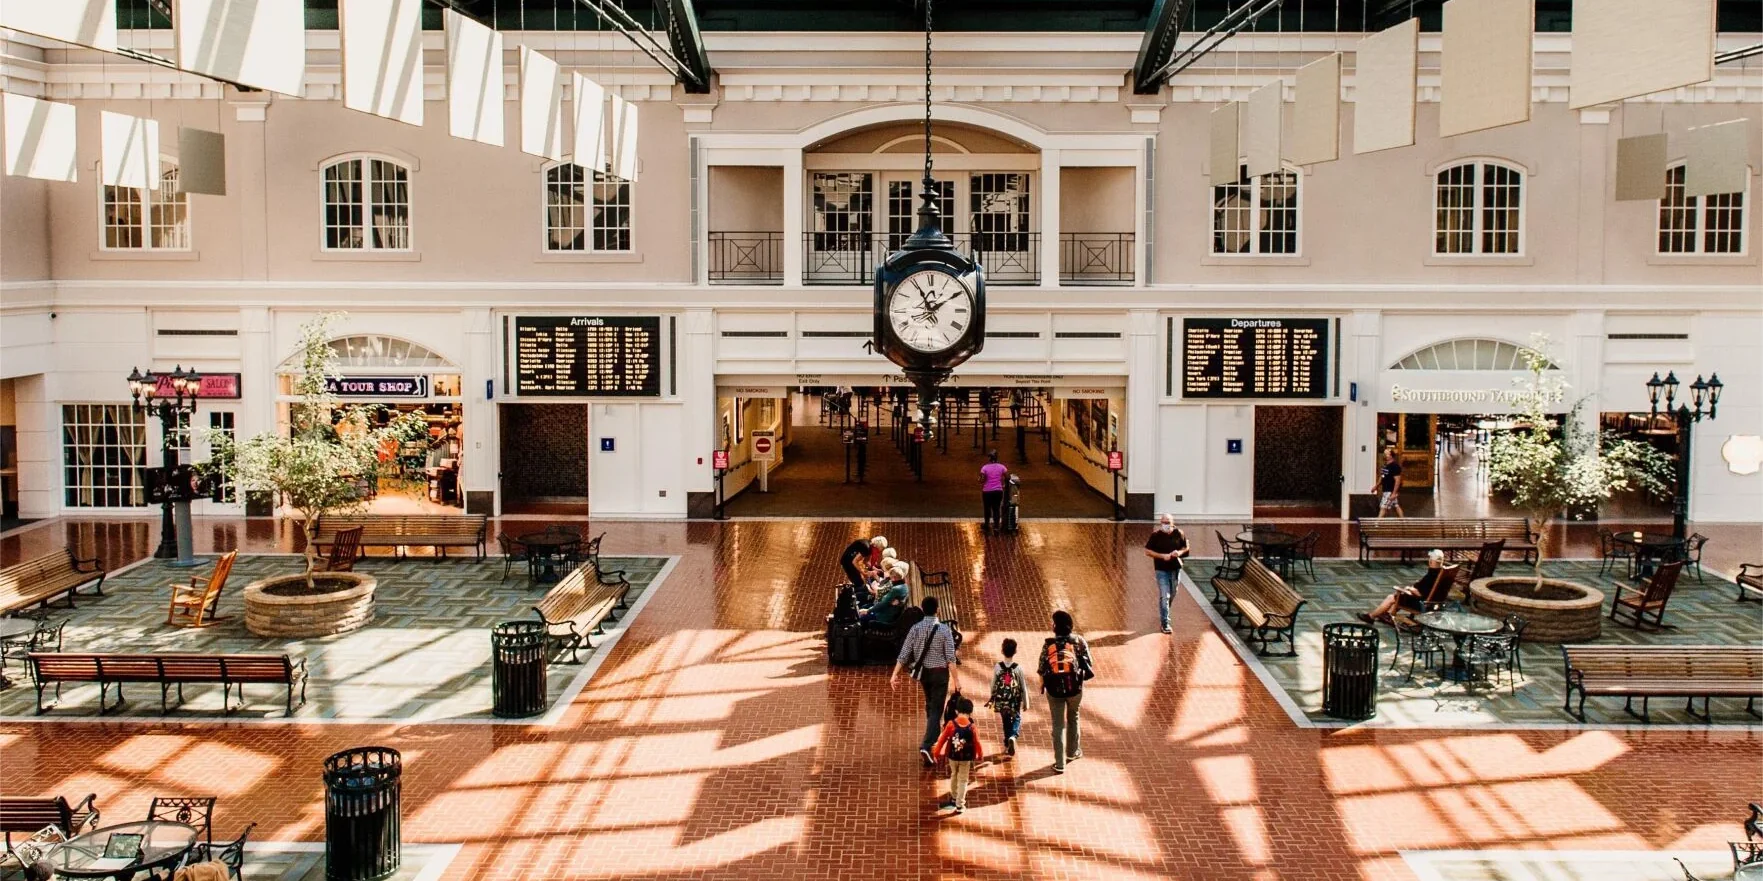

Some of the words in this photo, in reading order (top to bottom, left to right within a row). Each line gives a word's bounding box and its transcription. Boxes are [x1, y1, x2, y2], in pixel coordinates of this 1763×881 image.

[570, 317, 604, 326] Arrivals
[1231, 319, 1282, 328] Departures
[341, 382, 374, 392] TOUR
[379, 382, 412, 392] SHOP
